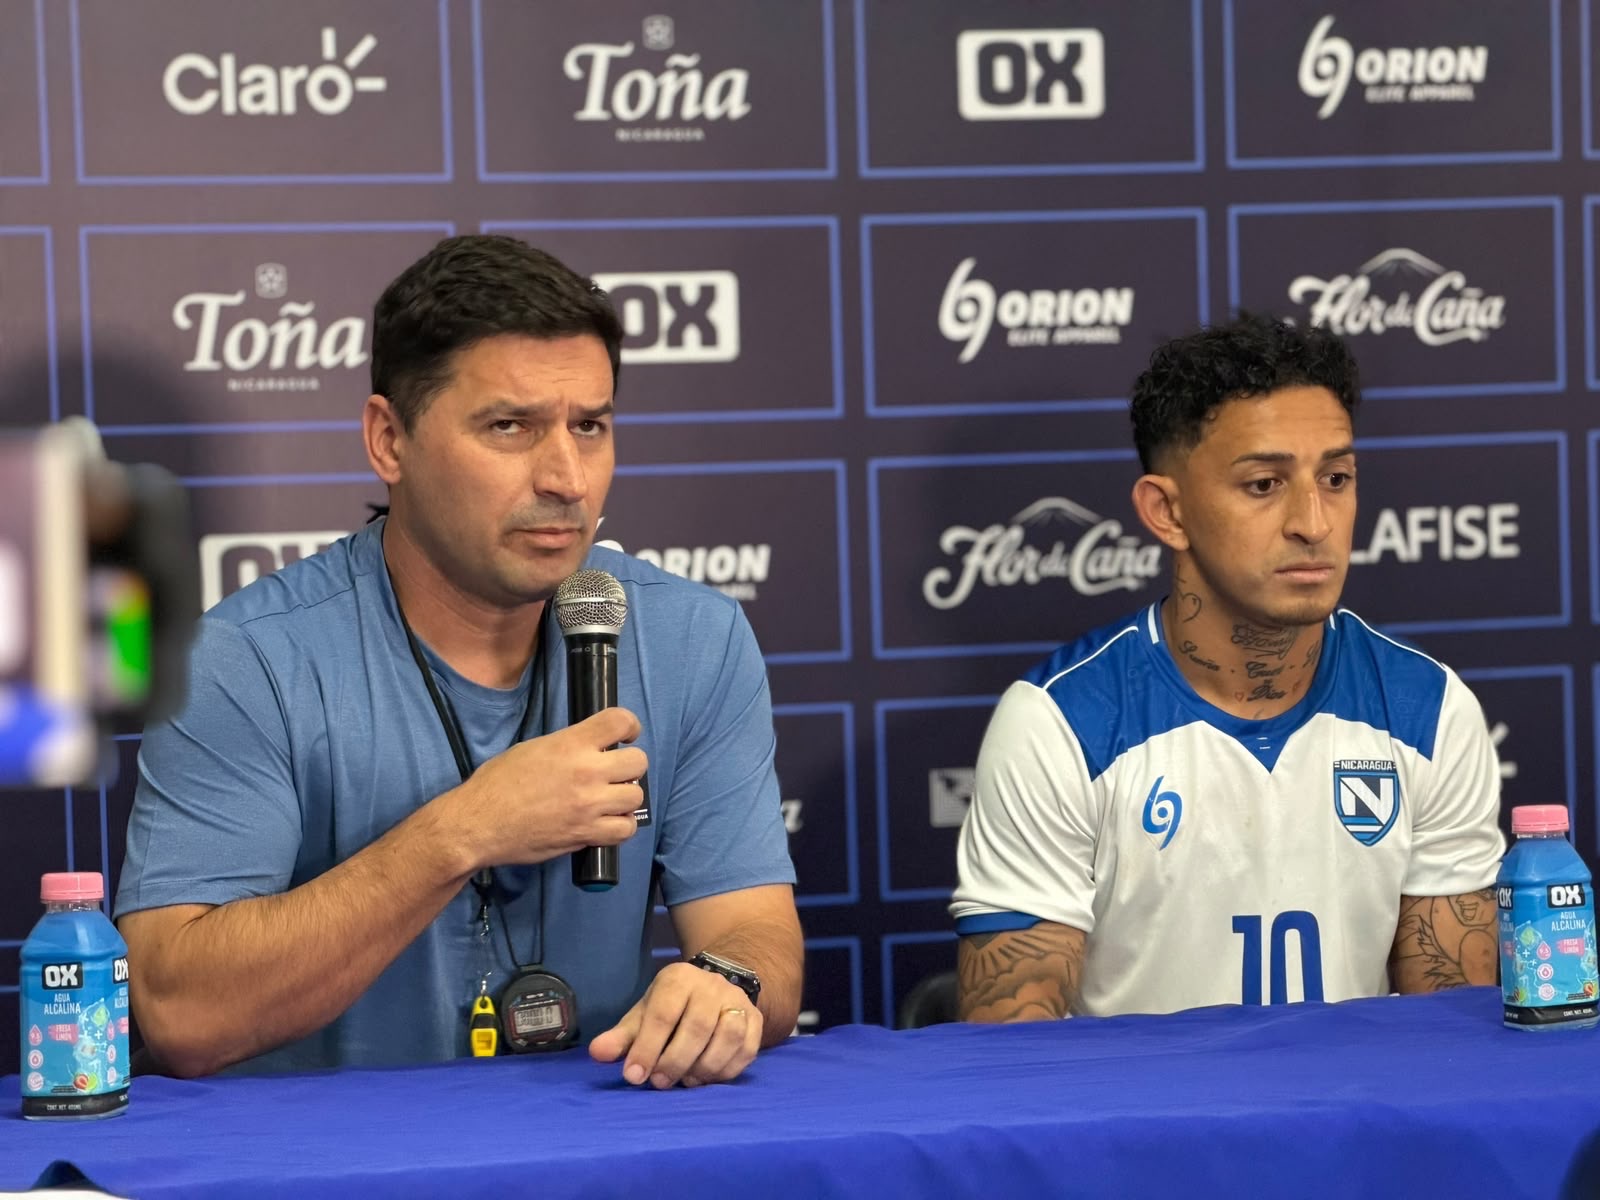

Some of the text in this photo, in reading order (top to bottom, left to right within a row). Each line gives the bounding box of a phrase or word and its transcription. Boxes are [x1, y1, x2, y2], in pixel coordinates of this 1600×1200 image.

[162, 30, 376, 116] Claro
[563, 41, 752, 122] Toña
[978, 41, 1084, 105] OX
[1355, 45, 1489, 84] ORION
[172, 290, 369, 371] Toña
[608, 284, 718, 349] OX
[997, 287, 1135, 328] ORION
[1414, 270, 1505, 347] Caña
[922, 523, 1041, 610] Flor
[1067, 519, 1162, 596] Caña
[1340, 760, 1393, 771] NICARAGUA
[1551, 885, 1581, 905] OX
[1561, 911, 1576, 920] AGUA
[45, 964, 78, 987] OX
[1232, 910, 1324, 1006] 10
[54, 993, 70, 1002] AGUA
